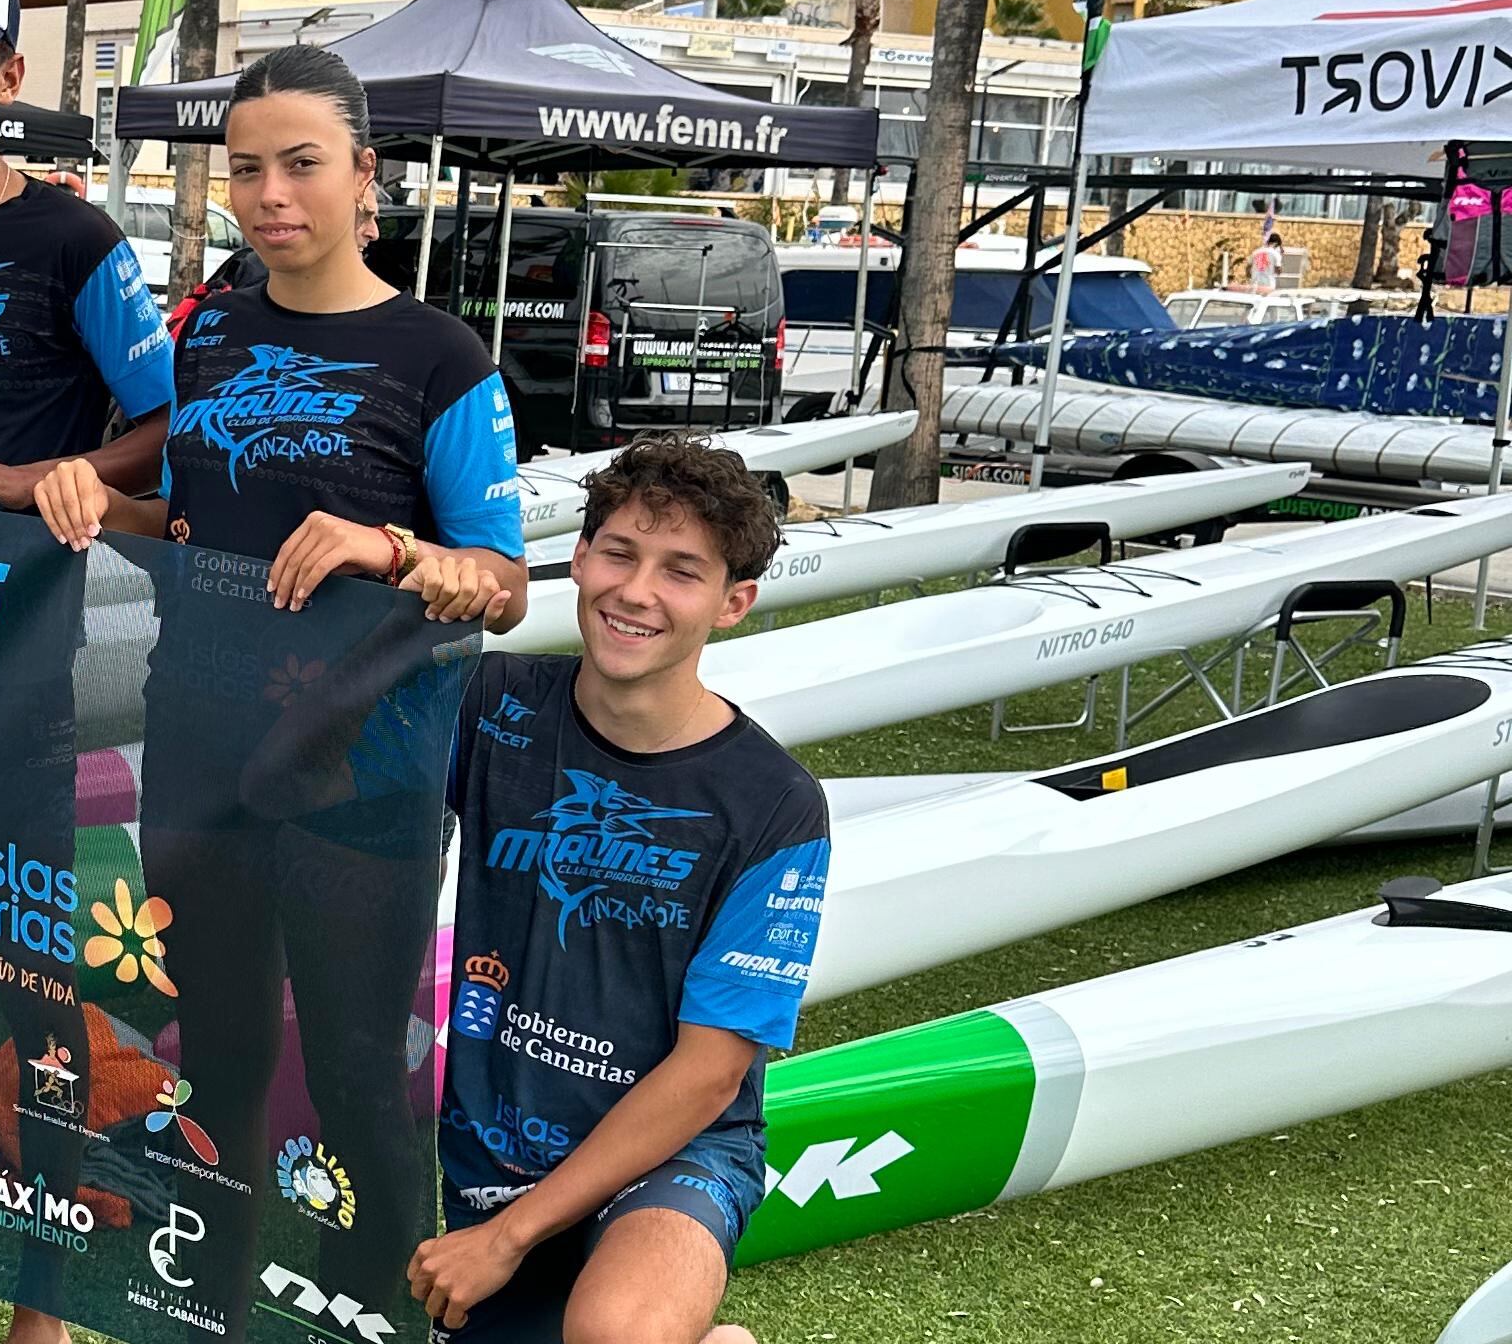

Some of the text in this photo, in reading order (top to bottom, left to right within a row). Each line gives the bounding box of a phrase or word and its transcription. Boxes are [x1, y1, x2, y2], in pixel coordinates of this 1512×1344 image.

[538, 103, 788, 156] www.fenn.fr
[169, 393, 366, 438] MARLINES
[243, 428, 355, 471] LANZAROTE
[788, 553, 822, 577] 600
[1035, 618, 1135, 661] NITRO 640
[485, 828, 702, 881] MARLINES
[578, 894, 690, 930] LANZAROTE
[21, 967, 42, 994] DE
[42, 976, 76, 1008] VIDA
[719, 951, 811, 981] MARLINE
[505, 1001, 615, 1058] Gobierno
[499, 1024, 637, 1086] de Canarias
[494, 1093, 571, 1148] Islas
[275, 1134, 357, 1231] JUEGO LIMPIO
[126, 1289, 159, 1313] PÉREZ
[166, 1304, 227, 1337] CABALLERO
